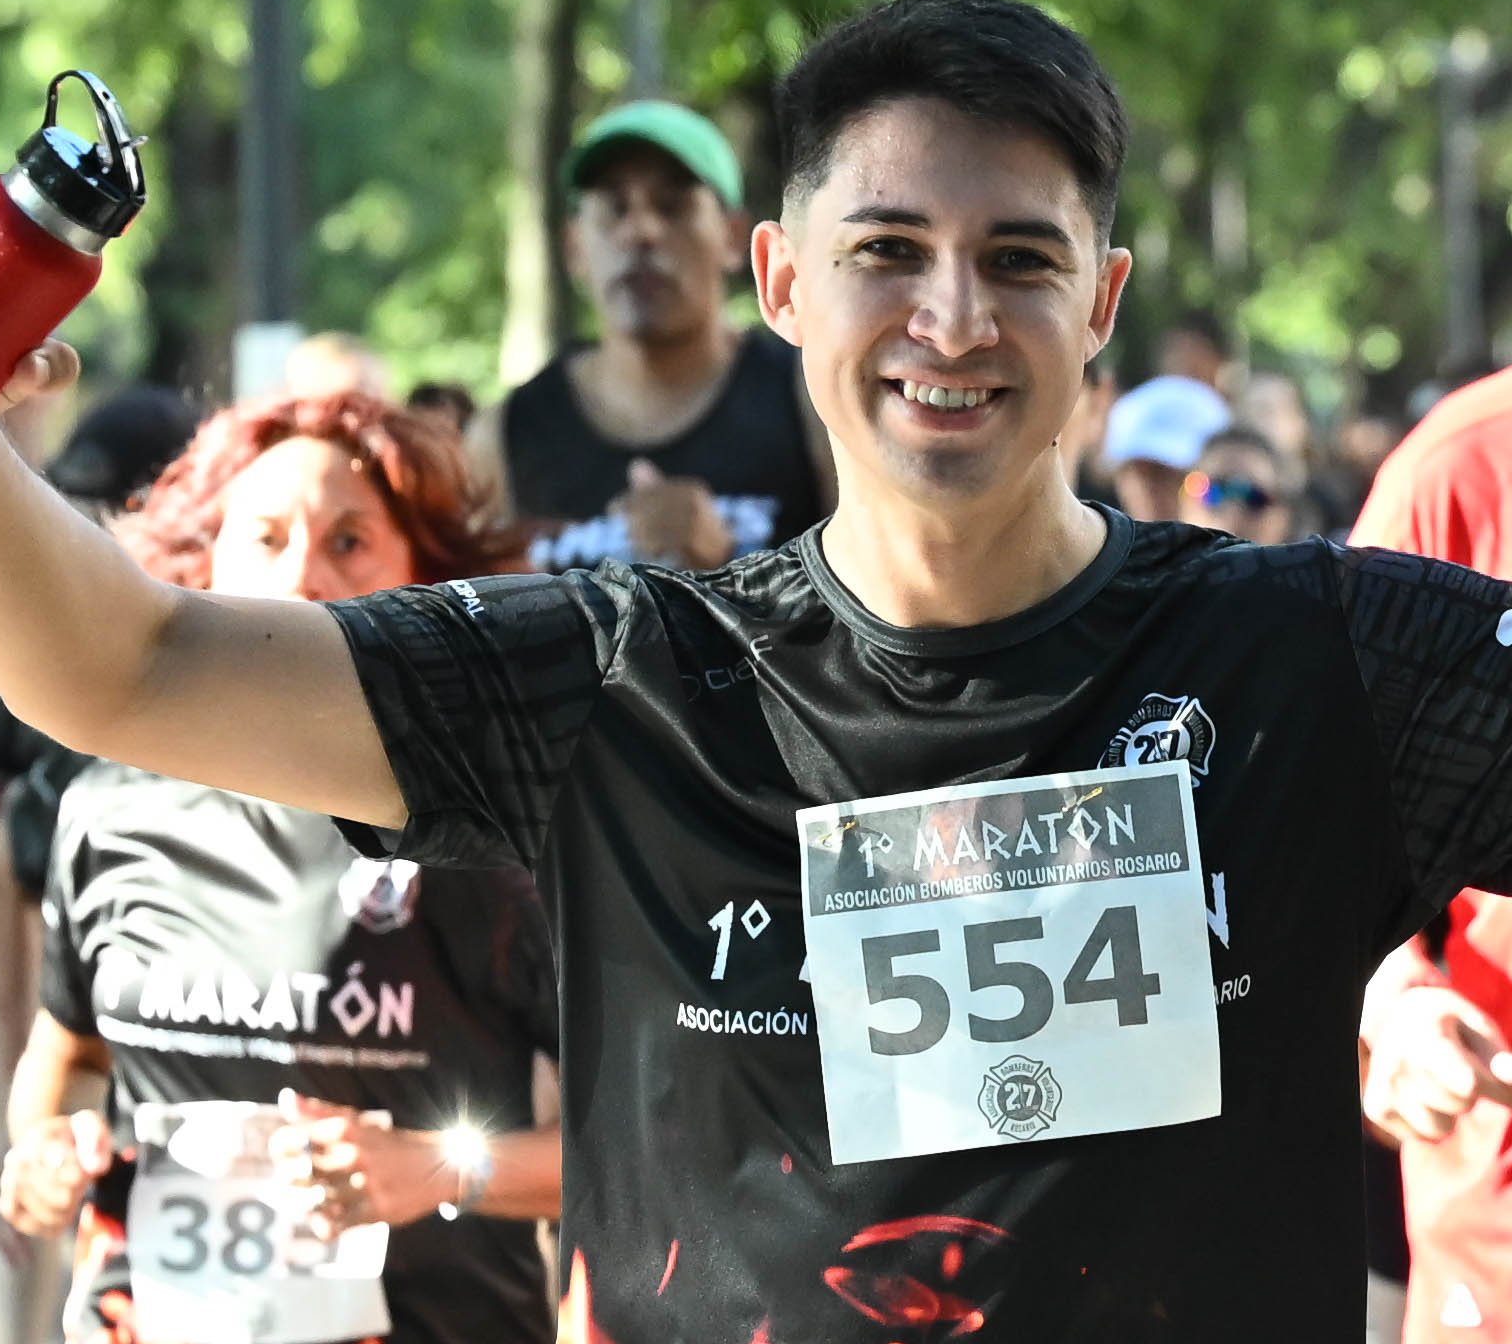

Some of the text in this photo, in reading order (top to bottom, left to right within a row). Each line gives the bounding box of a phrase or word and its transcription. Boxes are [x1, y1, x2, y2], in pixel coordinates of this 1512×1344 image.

[824, 851, 1181, 912] ASOCIACIÓN BOMBEROS VOLUNTARIOS ROSARIO
[139, 959, 416, 1038] MARATÓN
[861, 904, 1162, 1056] 554
[676, 1002, 808, 1036] ASOCIACIÓN
[1004, 1082, 1037, 1111] 27
